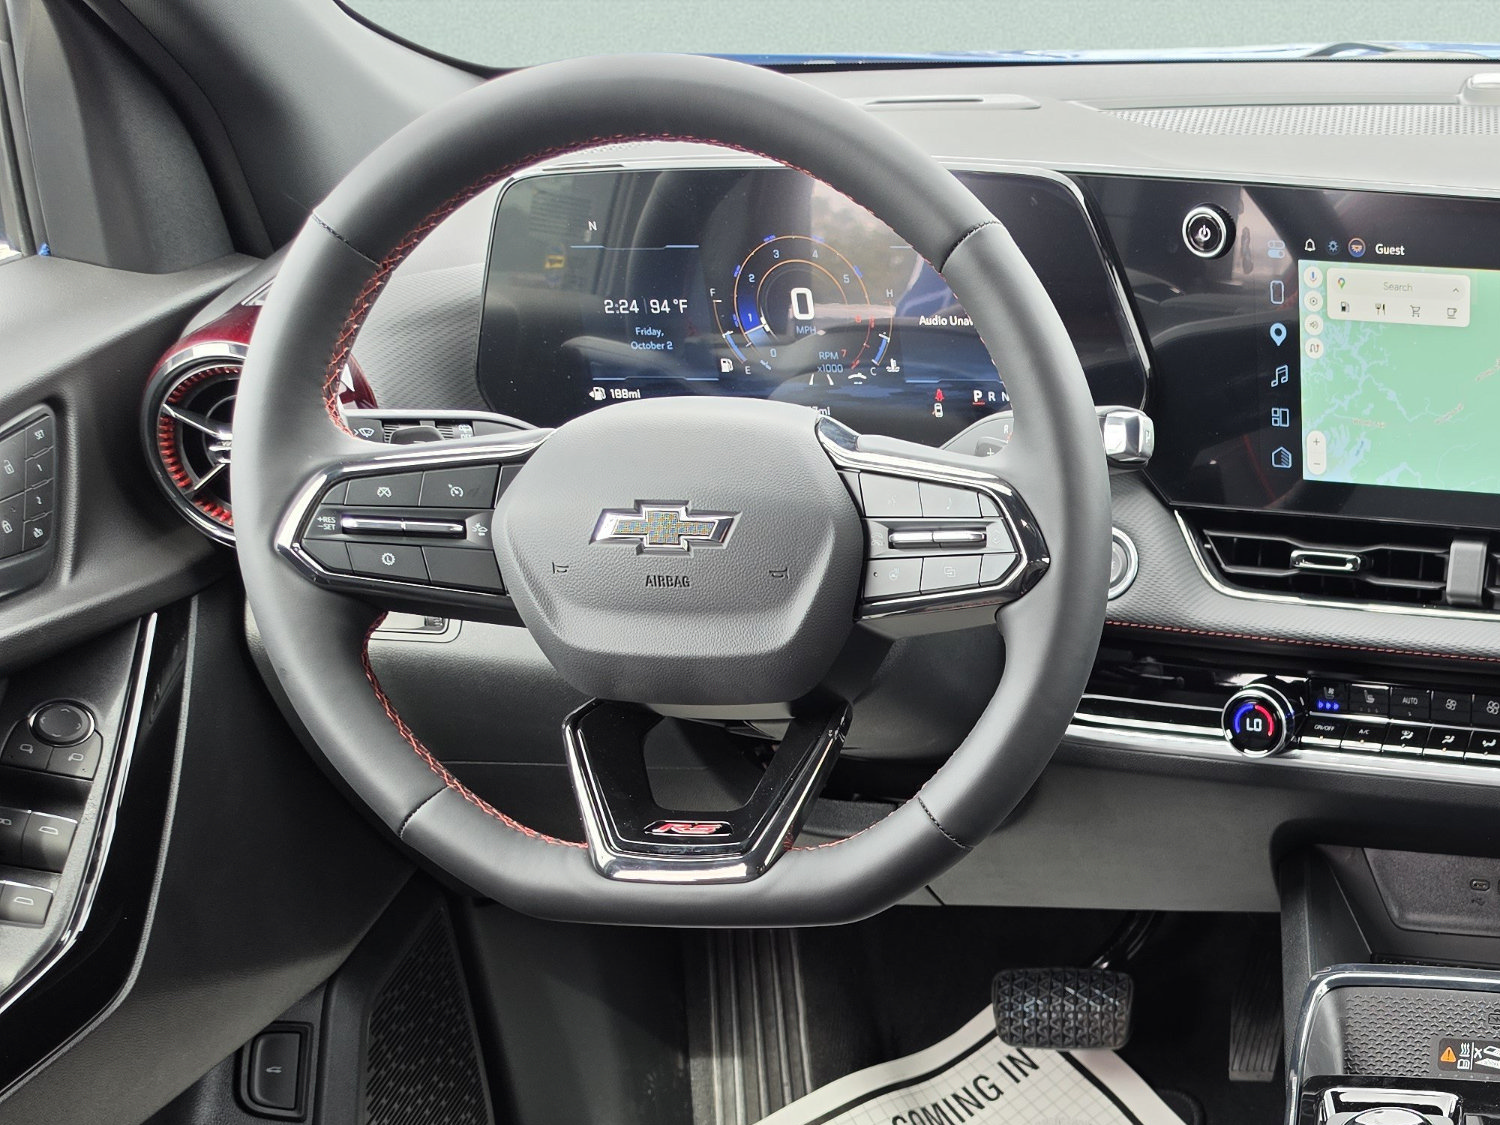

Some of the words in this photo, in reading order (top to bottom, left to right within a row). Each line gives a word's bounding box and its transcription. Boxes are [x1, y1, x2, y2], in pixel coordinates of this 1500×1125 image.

[588, 221, 597, 231] N
[773, 249, 780, 259] 3
[812, 250, 819, 259] 4
[1375, 243, 1405, 256] Guest
[748, 273, 756, 283] 2
[843, 274, 850, 284] 5
[1383, 281, 1413, 292] Search
[709, 288, 716, 297] F
[886, 289, 894, 297] H
[604, 299, 640, 314] 2:24
[790, 287, 815, 320] 0
[919, 315, 948, 326] Audio
[635, 327, 664, 338] Friday,
[796, 325, 817, 335] MPH
[630, 341, 665, 350] October
[666, 341, 674, 350] 2
[818, 351, 838, 360] RPM
[745, 365, 751, 375] E
[817, 364, 844, 373] x1000
[870, 367, 877, 376] C
[973, 390, 982, 402] P
[988, 391, 996, 402] R
[1001, 392, 1010, 402] N
[34, 429, 45, 441] SET
[317, 516, 336, 524] +RES
[645, 575, 690, 587] AIRBAG
[1402, 696, 1418, 705] AUTO
[1246, 718, 1263, 732] LO
[1314, 724, 1336, 732] ON/OFF
[652, 823, 722, 834] RS
[997, 1047, 1040, 1084] IN
